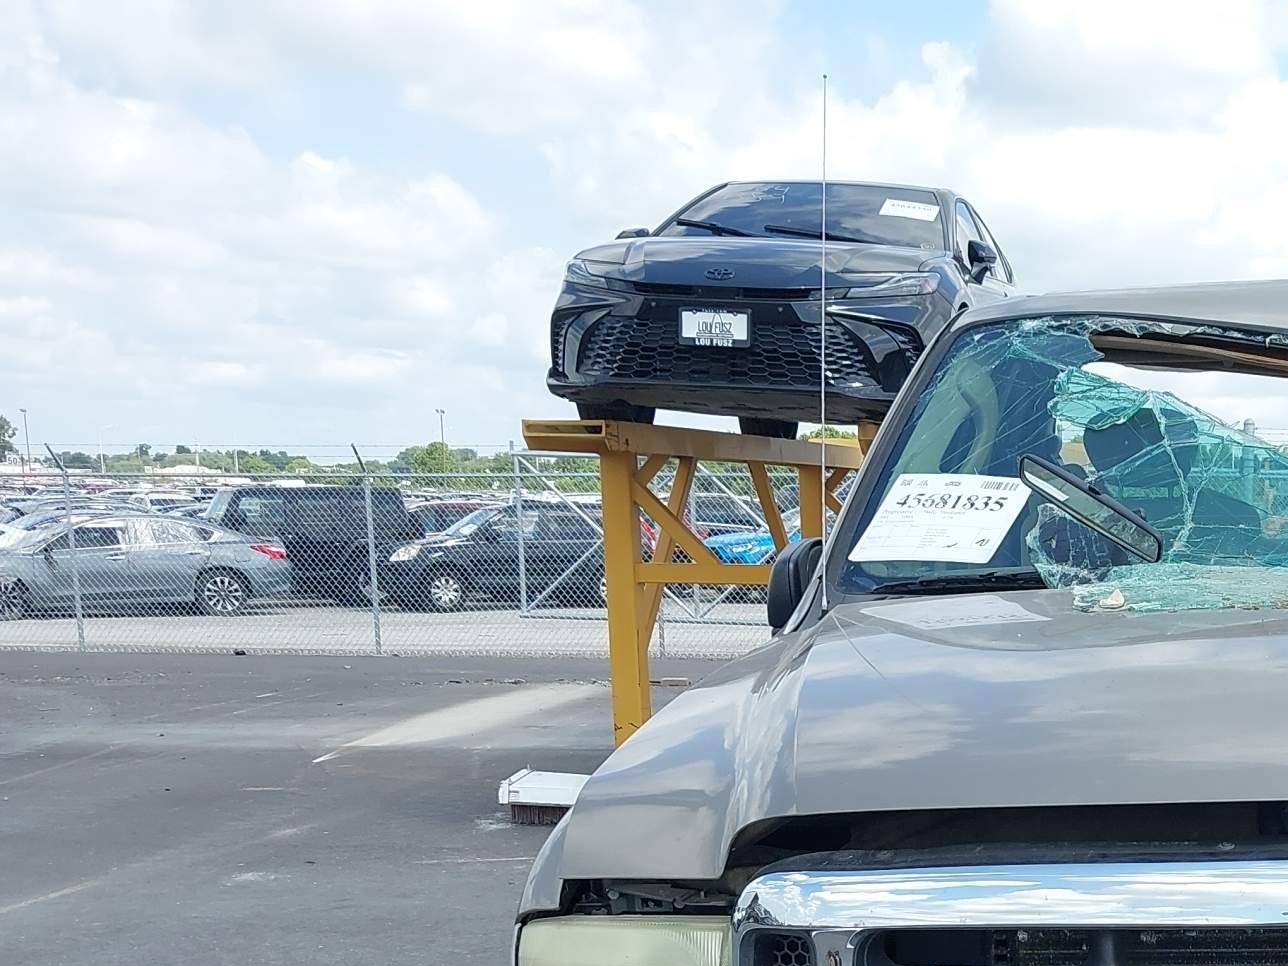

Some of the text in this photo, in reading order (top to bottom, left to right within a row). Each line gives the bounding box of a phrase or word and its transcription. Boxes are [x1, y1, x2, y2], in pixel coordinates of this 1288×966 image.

[698, 321, 733, 333] LOU FUSZ
[695, 338, 733, 347] LOU FUSZ
[896, 493, 1008, 512] 45681835
